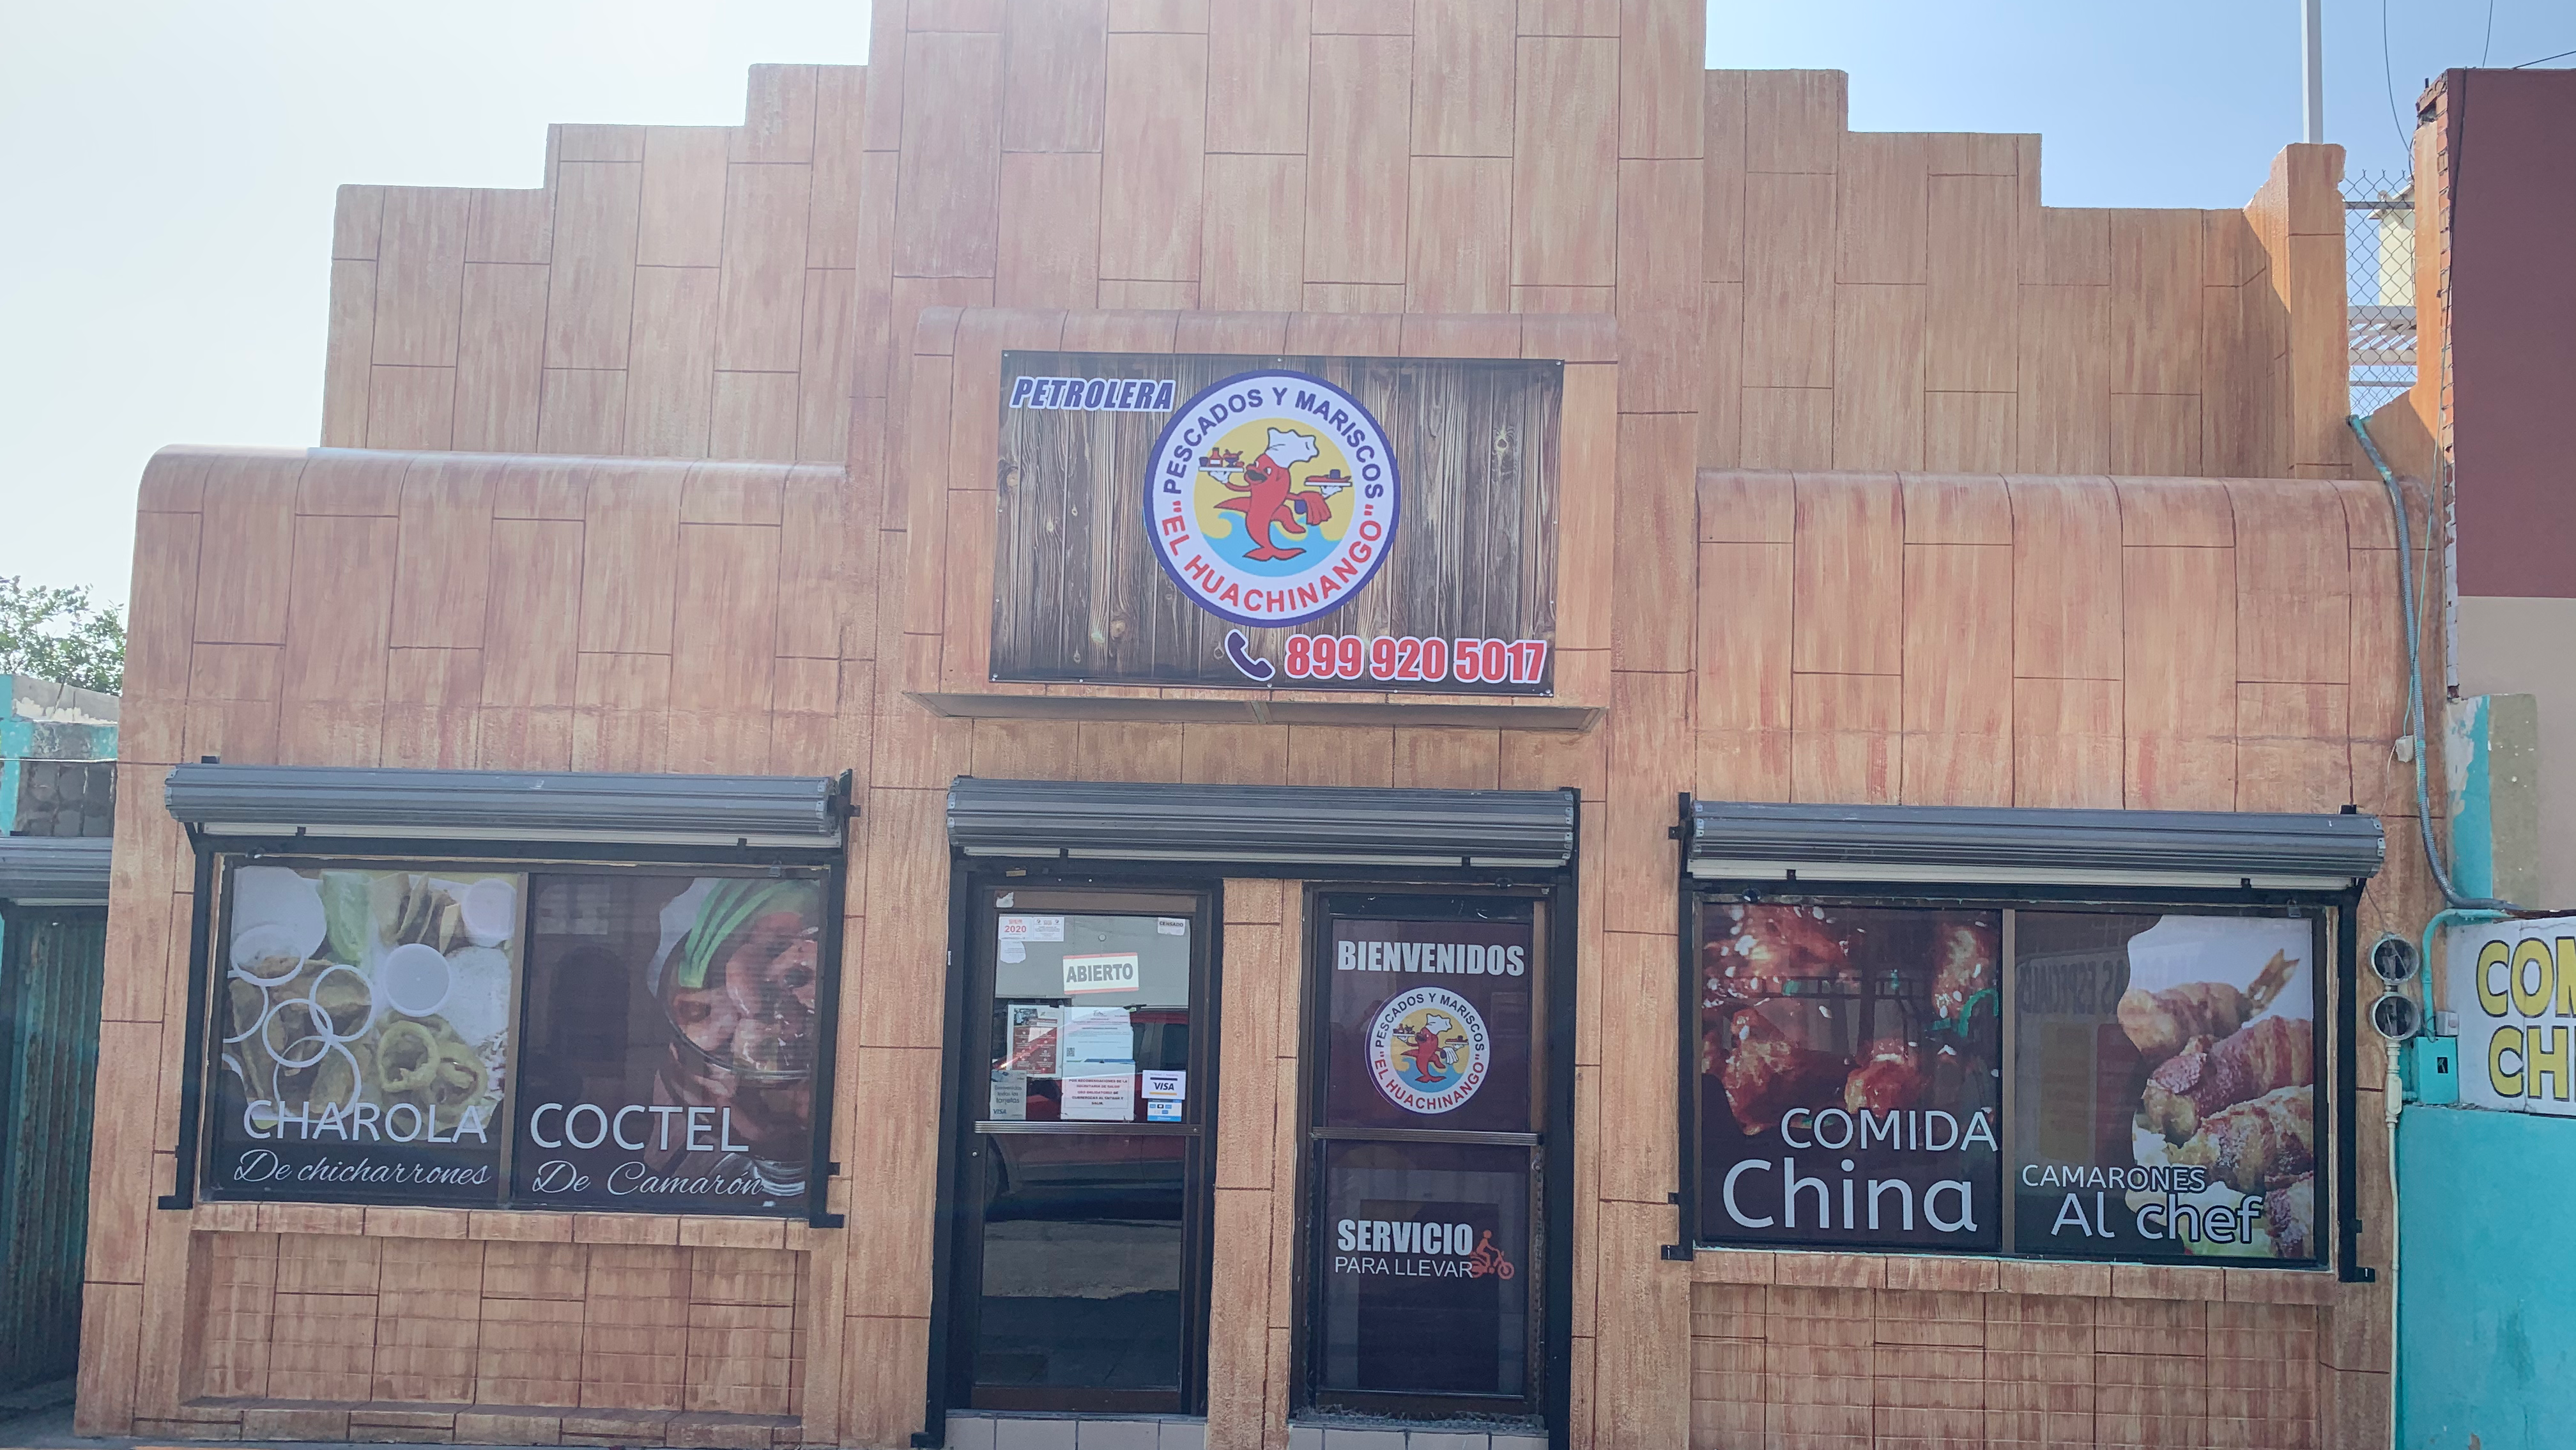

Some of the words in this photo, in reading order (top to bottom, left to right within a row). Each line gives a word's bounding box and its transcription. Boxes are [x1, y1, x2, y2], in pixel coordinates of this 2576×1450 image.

[1010, 377, 1175, 411] PETROLERA
[1163, 389, 1263, 494] PESCADOS
[1272, 387, 1287, 405] Y
[1295, 390, 1383, 498] MARISCOS
[1285, 635, 1364, 679] 899
[1370, 637, 1447, 682] 920
[1455, 638, 1546, 683] 5017
[1066, 963, 1133, 983] ABIERTO
[1337, 941, 1524, 976] BIENVENIDOS
[1376, 994, 1424, 1048] PESCADOS
[1429, 993, 1436, 1002] Y
[1440, 995, 1484, 1051] MARISCOS
[2488, 1025, 2576, 1102] CH
[244, 1100, 487, 1144] CHAROLA
[530, 1103, 749, 1152] COCTEL
[1781, 1107, 1998, 1152] COMIDA
[234, 1149, 292, 1182] De
[297, 1157, 491, 1185] chicharrones
[532, 1160, 590, 1193] De
[608, 1161, 763, 1195] Camarón
[2022, 1164, 2205, 1192] CAMARONES
[1723, 1157, 1978, 1232] China
[1338, 1219, 1473, 1256] SERVICIO
[2051, 1192, 2115, 1238] Al
[2136, 1193, 2264, 1242] chef
[1335, 1256, 1390, 1275] PARA
[1395, 1259, 1473, 1278] LLEVAR
